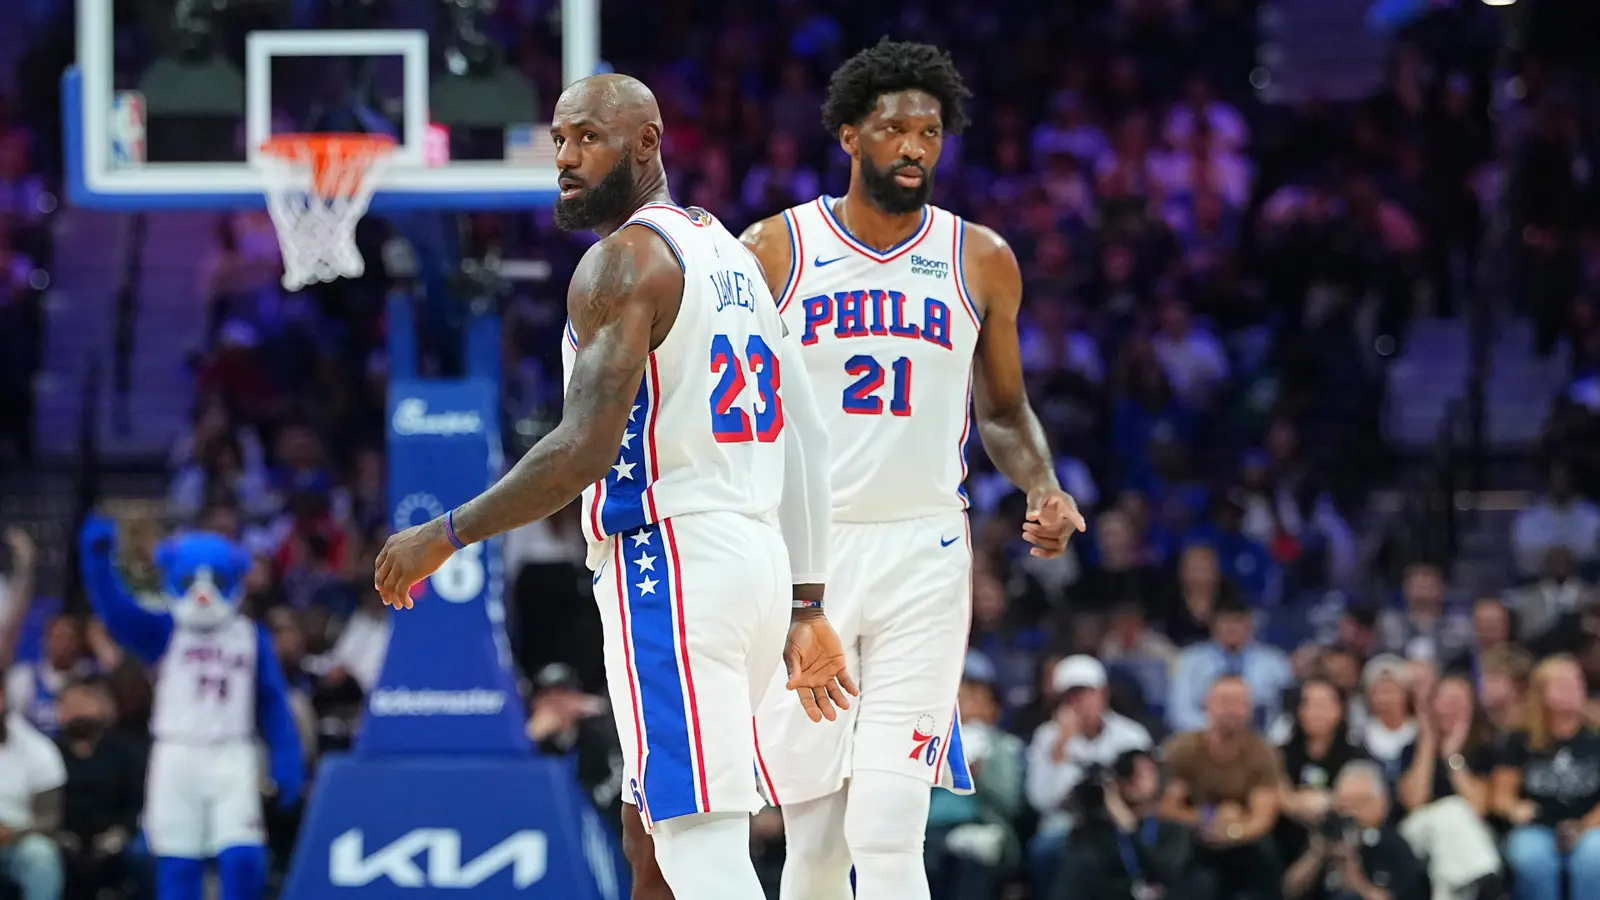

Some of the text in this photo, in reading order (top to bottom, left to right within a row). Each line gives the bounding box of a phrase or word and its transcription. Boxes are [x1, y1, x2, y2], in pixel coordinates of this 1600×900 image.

[911, 255, 948, 270] Bloom
[911, 266, 948, 280] energy
[709, 270, 755, 313] JAMES
[801, 289, 952, 351] PHILA
[709, 334, 784, 442] 23
[842, 355, 912, 416] 21
[409, 540, 485, 603] 6
[909, 728, 940, 766] 76
